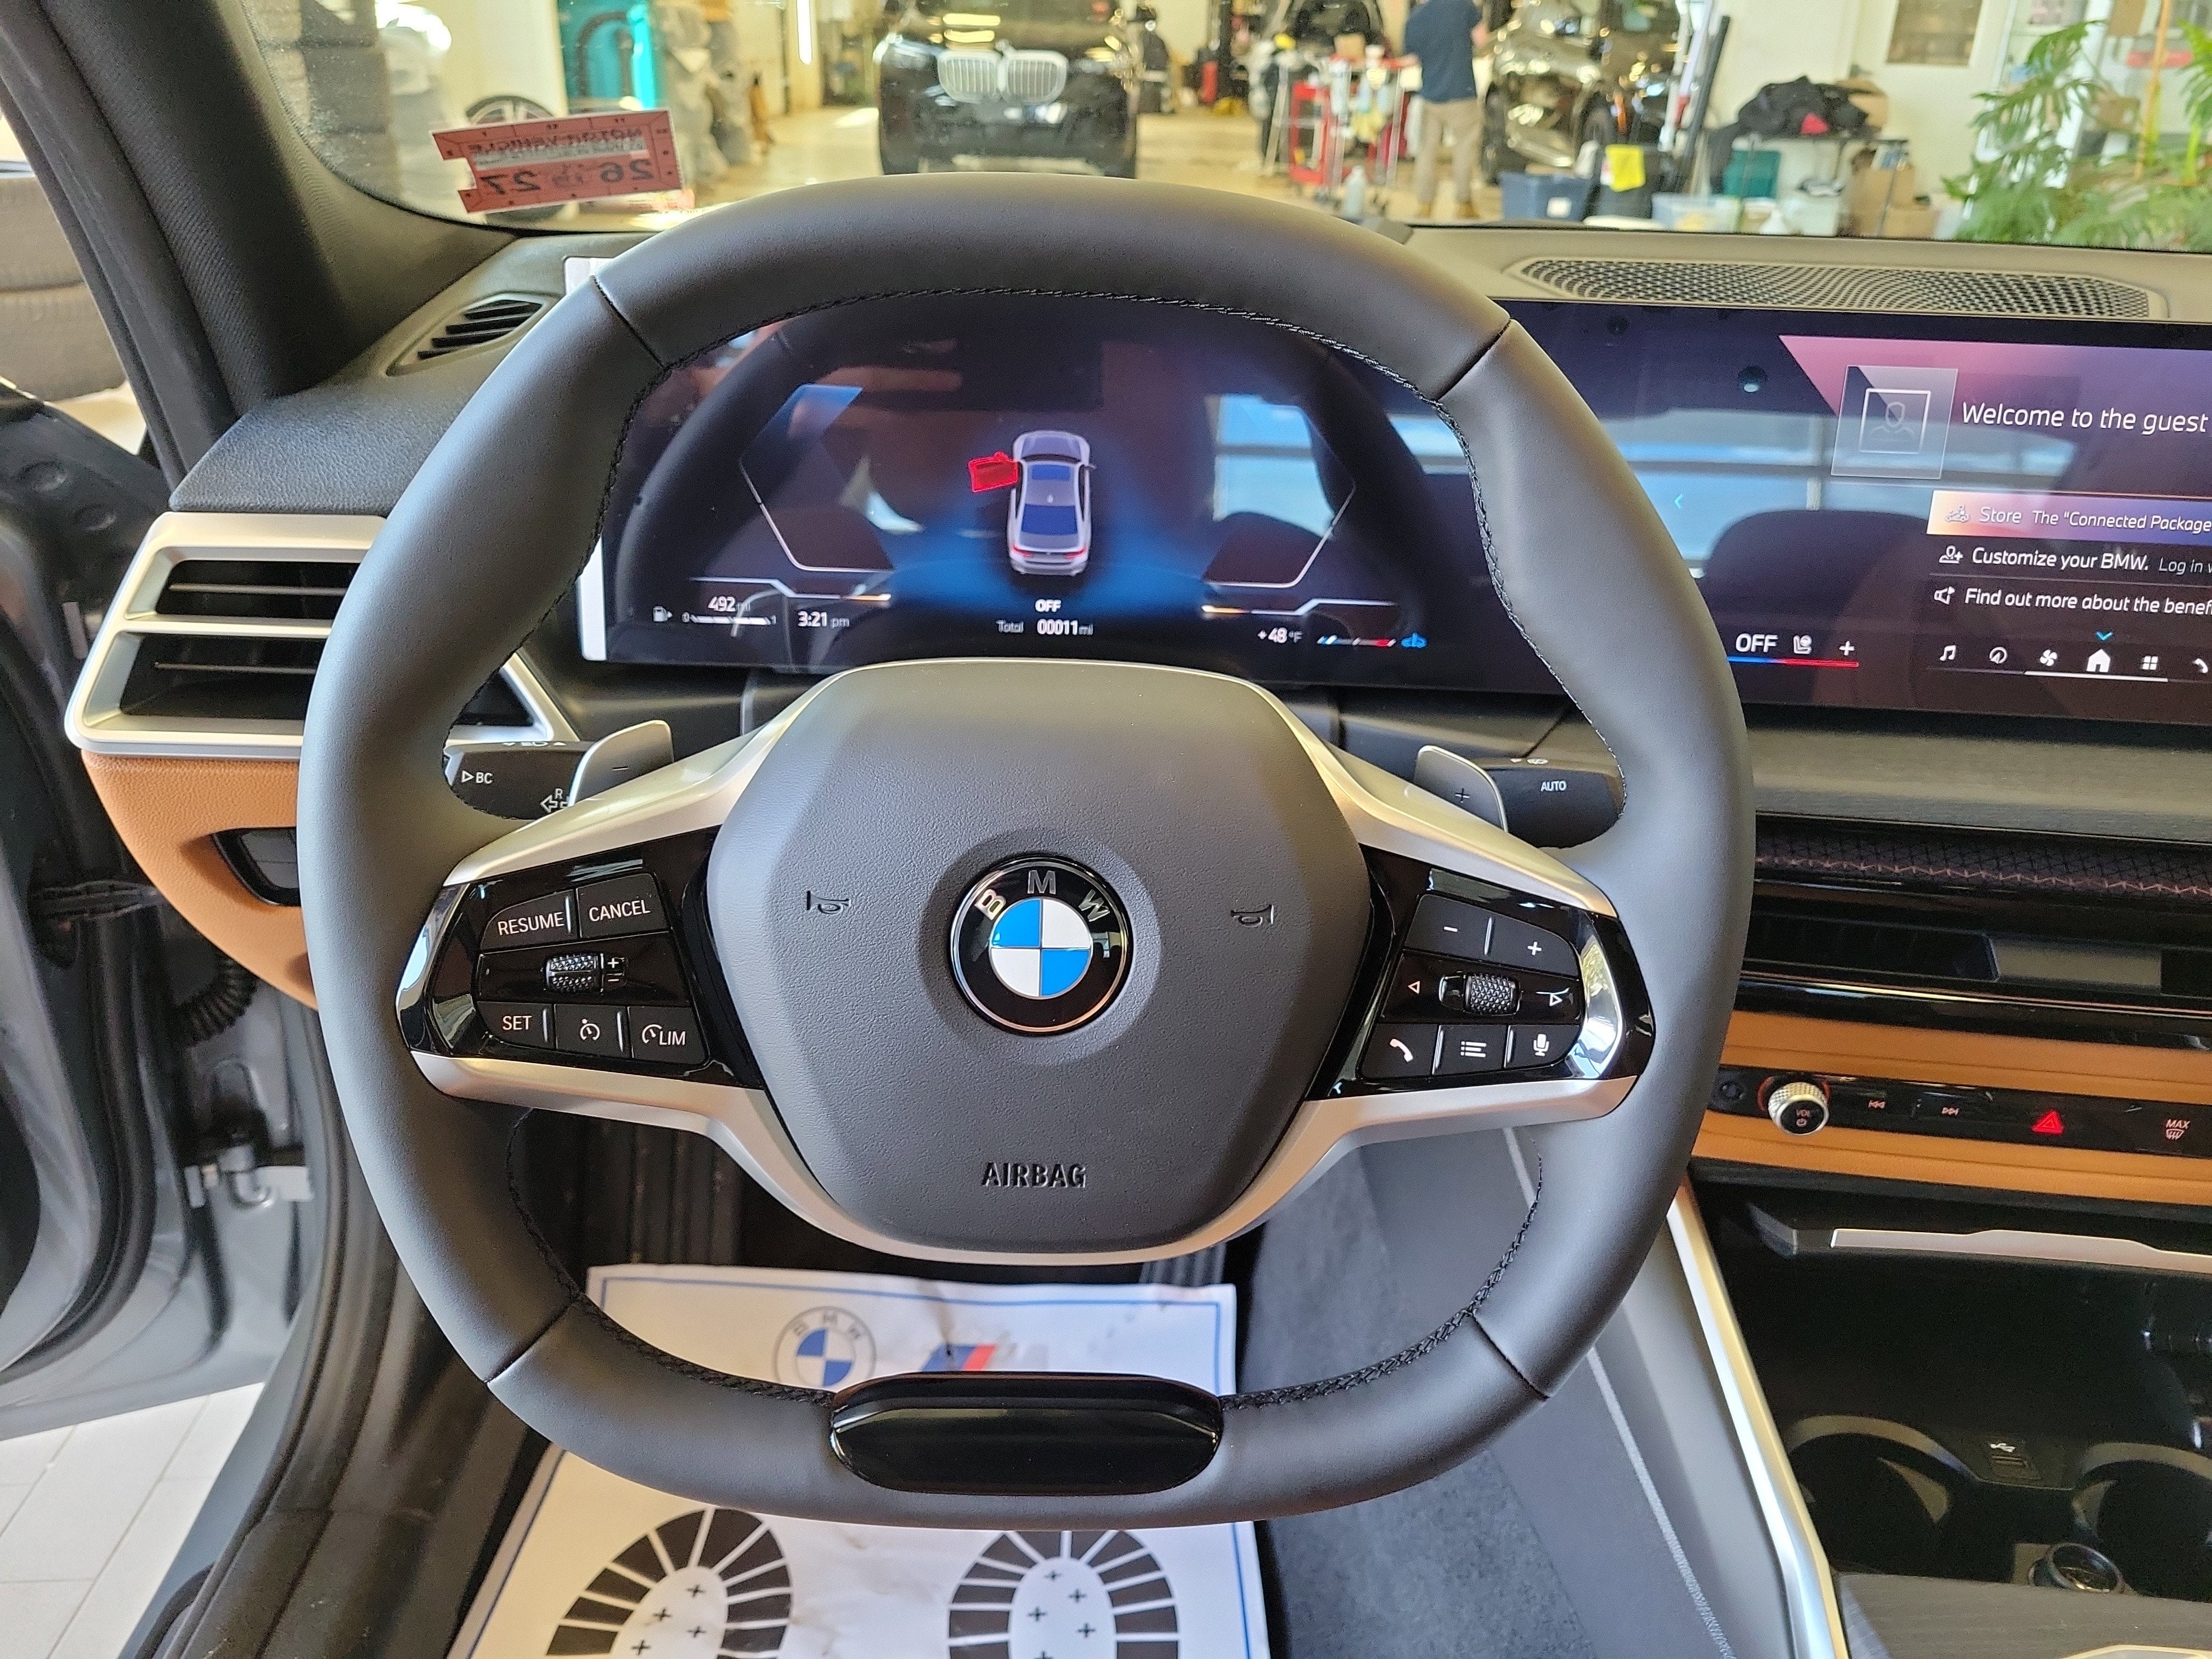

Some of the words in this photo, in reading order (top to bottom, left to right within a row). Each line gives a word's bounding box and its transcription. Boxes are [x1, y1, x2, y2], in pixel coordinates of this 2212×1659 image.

[1962, 402, 2065, 427] Welcome
[2071, 408, 2093, 428] to
[2100, 408, 2136, 430] the
[2141, 413, 2209, 435] guest
[1979, 506, 2022, 523] Store
[2032, 510, 2059, 525] The
[2063, 511, 2147, 529] "Connected
[2150, 515, 2212, 534] Package
[1972, 547, 2056, 567] Customize
[2061, 554, 2098, 571] your
[2101, 552, 2148, 571] BMW.
[2159, 557, 2186, 575] Log
[2190, 559, 2203, 573] in
[708, 596, 736, 612] 492
[1035, 599, 1062, 612] OFF
[1965, 588, 2001, 606] Find
[2005, 593, 2031, 607] out
[2035, 594, 2078, 609] more
[2082, 594, 2129, 612] about
[2134, 596, 2160, 613] the
[797, 611, 827, 627] 3:21
[831, 616, 850, 628] pm
[996, 619, 1024, 633] Total
[1735, 633, 1779, 653] OFF
[476, 772, 493, 785] BC
[1540, 780, 1567, 792] AUTO
[975, 870, 1110, 922] BMW
[589, 899, 651, 922] CANCEL
[498, 911, 566, 935] RESUME
[502, 1015, 533, 1031] SET
[659, 1031, 686, 1046] LIM
[2166, 1119, 2191, 1130] MAX
[981, 1161, 1087, 1188] AIRBAG
